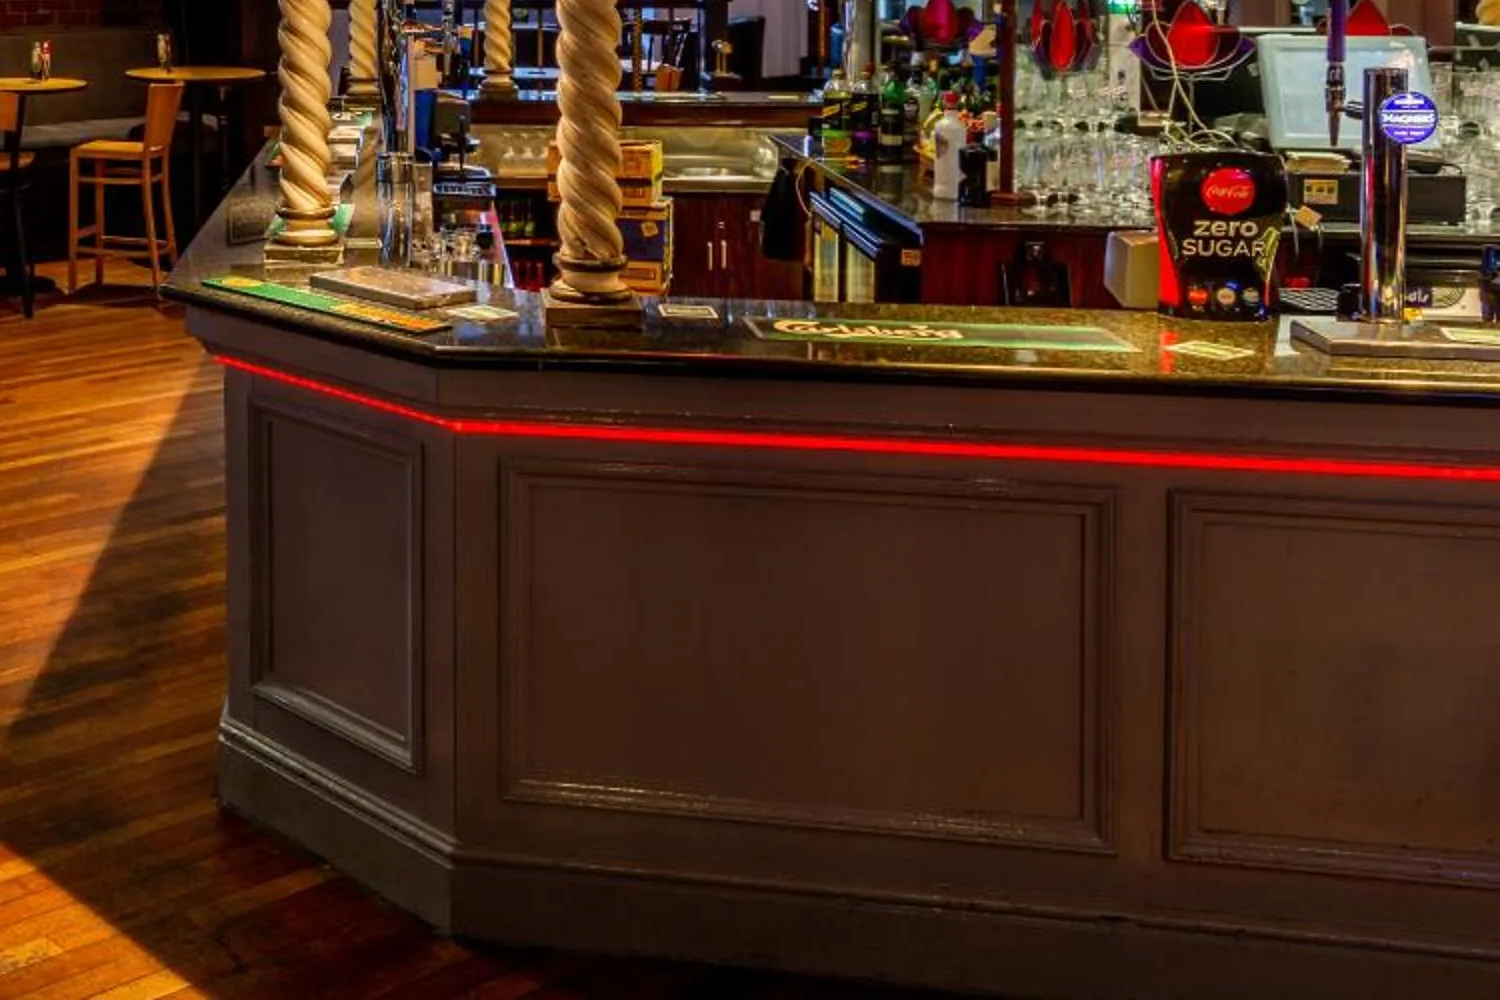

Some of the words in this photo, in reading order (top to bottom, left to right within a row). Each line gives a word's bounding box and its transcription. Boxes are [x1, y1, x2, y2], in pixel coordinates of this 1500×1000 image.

[1193, 220, 1259, 237] zero
[1182, 239, 1267, 257] SUGAR
[773, 319, 964, 339] Carlsberg
